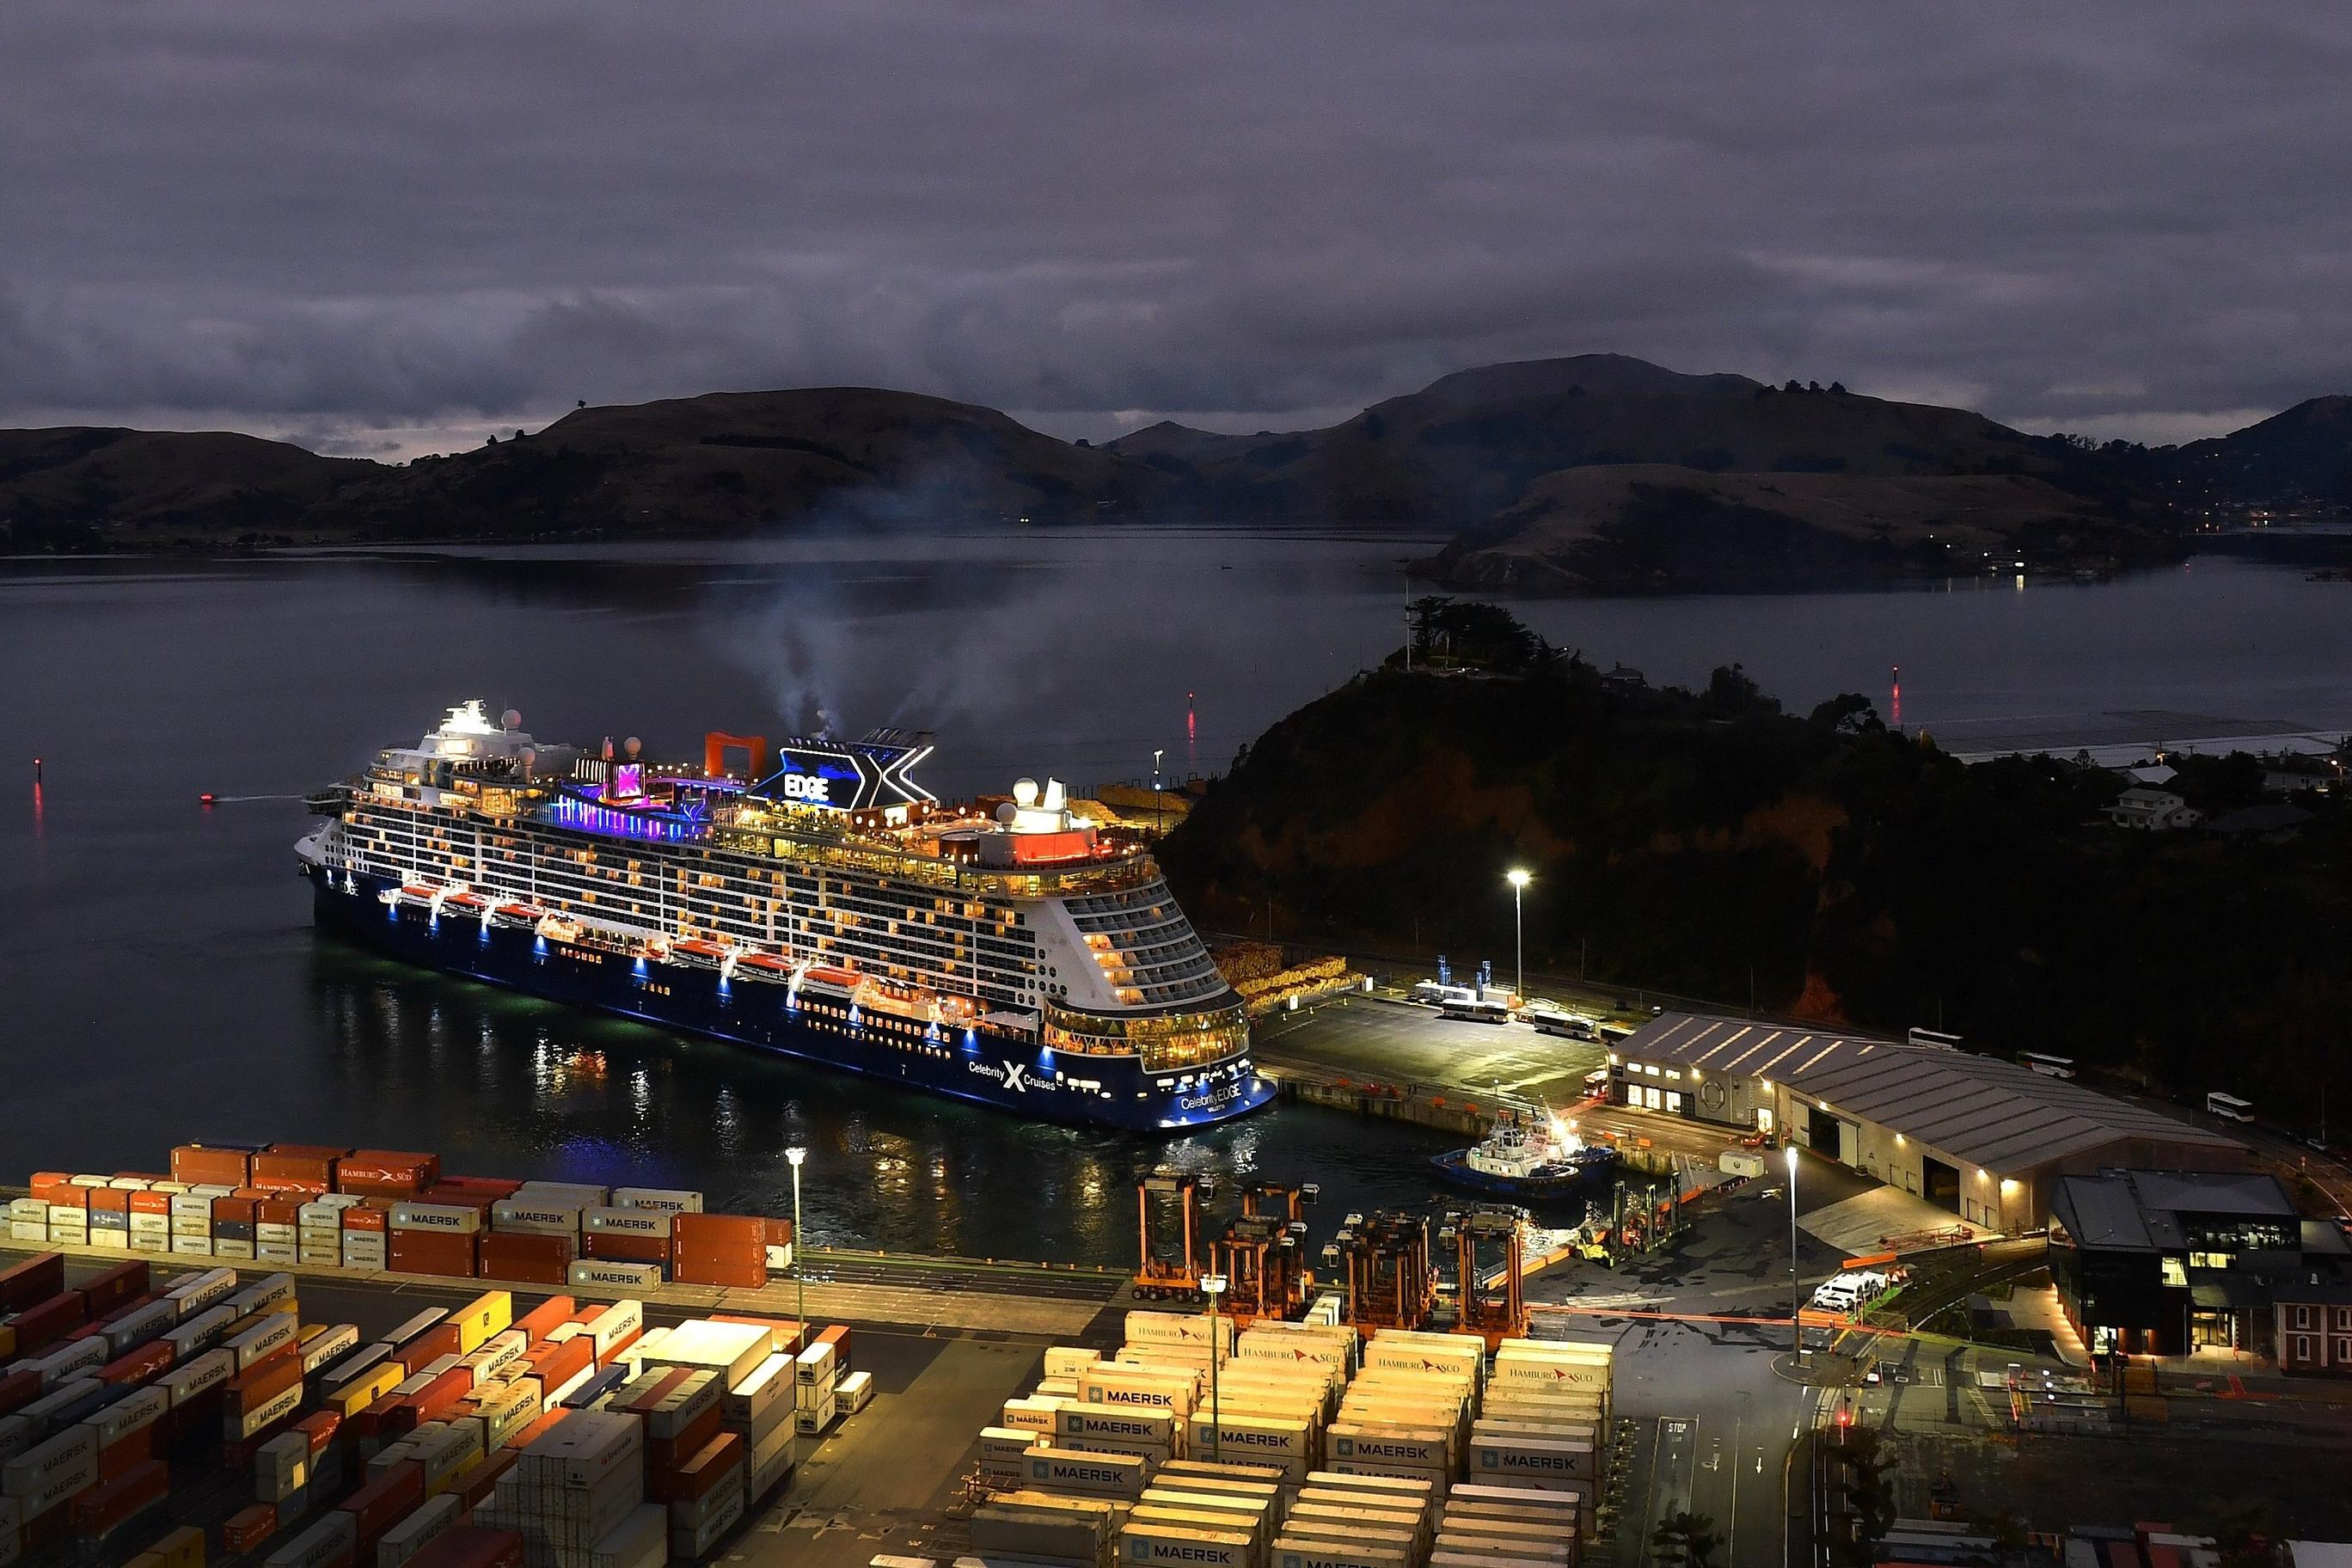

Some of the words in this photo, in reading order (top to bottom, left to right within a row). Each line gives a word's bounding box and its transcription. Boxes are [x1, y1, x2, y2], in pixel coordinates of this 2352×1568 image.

[784, 774, 830, 801] EDGE
[969, 1061, 1005, 1081] Celebrity
[1024, 1075, 1057, 1091] Cruises
[340, 1169, 379, 1179] HAMBURG
[396, 1172, 413, 1181] SÜD
[634, 1199, 683, 1211] MAERSK
[411, 1214, 460, 1226] MAERSK
[515, 1211, 564, 1223] MAERSK
[605, 1218, 656, 1230] MAERSK
[591, 1272, 642, 1284] MAERSK
[195, 1280, 231, 1304] MAERSK
[254, 1285, 288, 1308] MAERSK
[132, 1313, 168, 1337] MAERSK
[193, 1318, 230, 1345] MAERSK
[609, 1314, 637, 1340] MAERSK
[1138, 1326, 1182, 1338] HAMBURG
[254, 1325, 291, 1352] MAERSK
[318, 1337, 352, 1363] MAERSK
[60, 1350, 101, 1376] MAERSK
[488, 1344, 520, 1374] MAERSK
[1243, 1348, 1294, 1360] HAMBURG
[1320, 1353, 1340, 1363] SÜD
[1378, 1357, 1424, 1370] HAMBURG
[1442, 1363, 1460, 1373] SÜD
[189, 1363, 226, 1391] MAERSK
[1510, 1369, 1556, 1381] HAMBURG
[1574, 1373, 1593, 1383] SÜD
[260, 1393, 297, 1423] MAERSK
[503, 1393, 536, 1424] MAERSK
[685, 1388, 715, 1417] MAERSK
[1107, 1390, 1173, 1406] MAERSK
[119, 1400, 159, 1430] MAERSK
[1016, 1416, 1049, 1424] MAERSK
[1086, 1419, 1153, 1436] MAERSK
[1668, 1423, 1687, 1433] STOP
[440, 1433, 477, 1463] MAERSK
[1220, 1431, 1289, 1448] MAERSK
[43, 1440, 88, 1473] MAERSK
[1357, 1443, 1429, 1460] MAERSK
[1504, 1455, 1576, 1470] MAERSK
[992, 1468, 1020, 1478] MAERS
[1053, 1466, 1123, 1483] MAERSK
[43, 1468, 88, 1502] MAERSK
[707, 1475, 738, 1504] MAERSK
[707, 1504, 738, 1534] MAERSK
[306, 1532, 348, 1565] MAERSK
[1154, 1545, 1230, 1564] MAERSK
